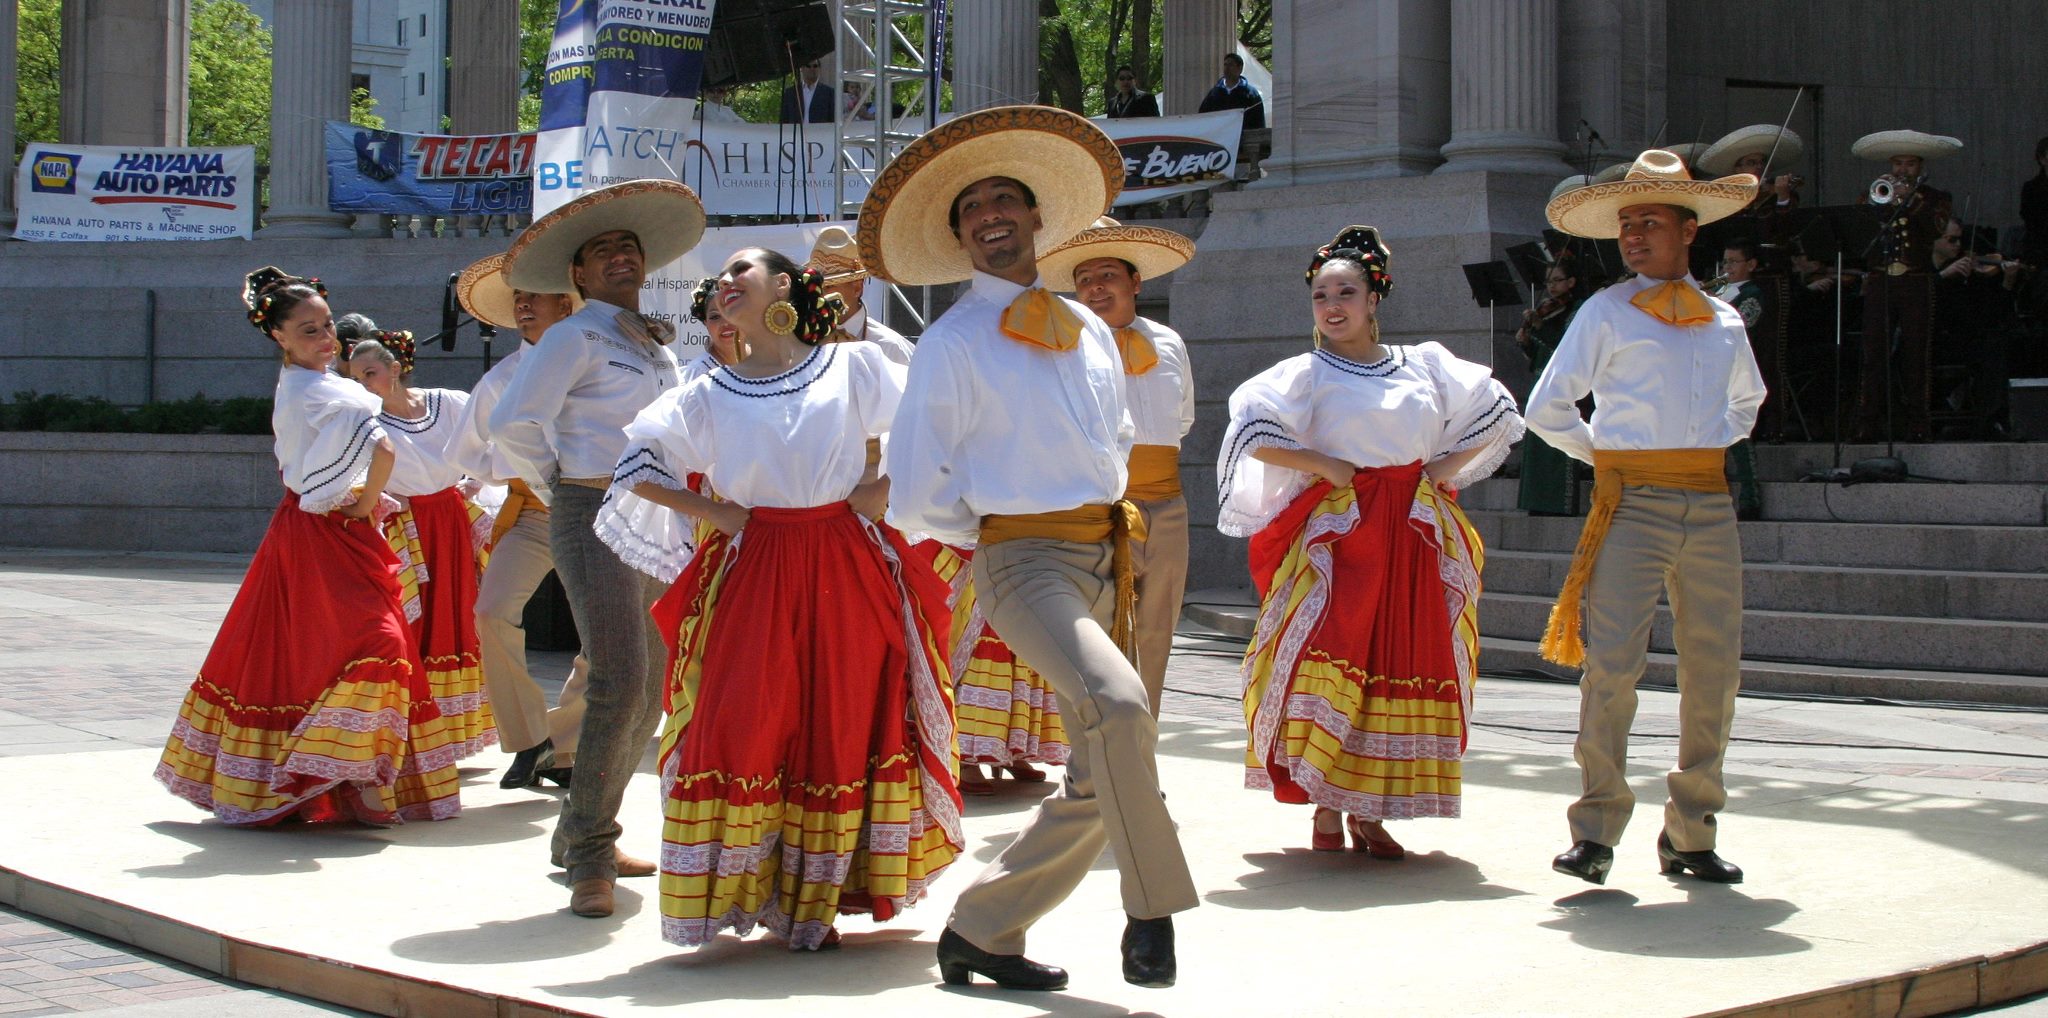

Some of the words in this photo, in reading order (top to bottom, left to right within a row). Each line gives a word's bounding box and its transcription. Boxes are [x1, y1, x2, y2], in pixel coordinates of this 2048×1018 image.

[646, 9, 654, 22] Y
[658, 12, 710, 28] MENUDEO
[618, 28, 703, 51] CONDICION
[562, 45, 584, 59] MAS
[40, 161, 67, 178] NAPA
[113, 153, 224, 174] HAVANA
[1141, 145, 1229, 178] BUENO
[93, 171, 159, 194] AUTO
[163, 174, 237, 197] PARTS
[723, 179, 770, 188] CHAMBER
[31, 215, 71, 226] HAVANA
[77, 219, 105, 229] AUTO
[109, 220, 142, 231] PARTS
[147, 223, 154, 231] &
[159, 223, 204, 233] MACHINE
[208, 225, 237, 235] SHOP
[60, 231, 88, 241] Colfax
[682, 331, 711, 346] Join
